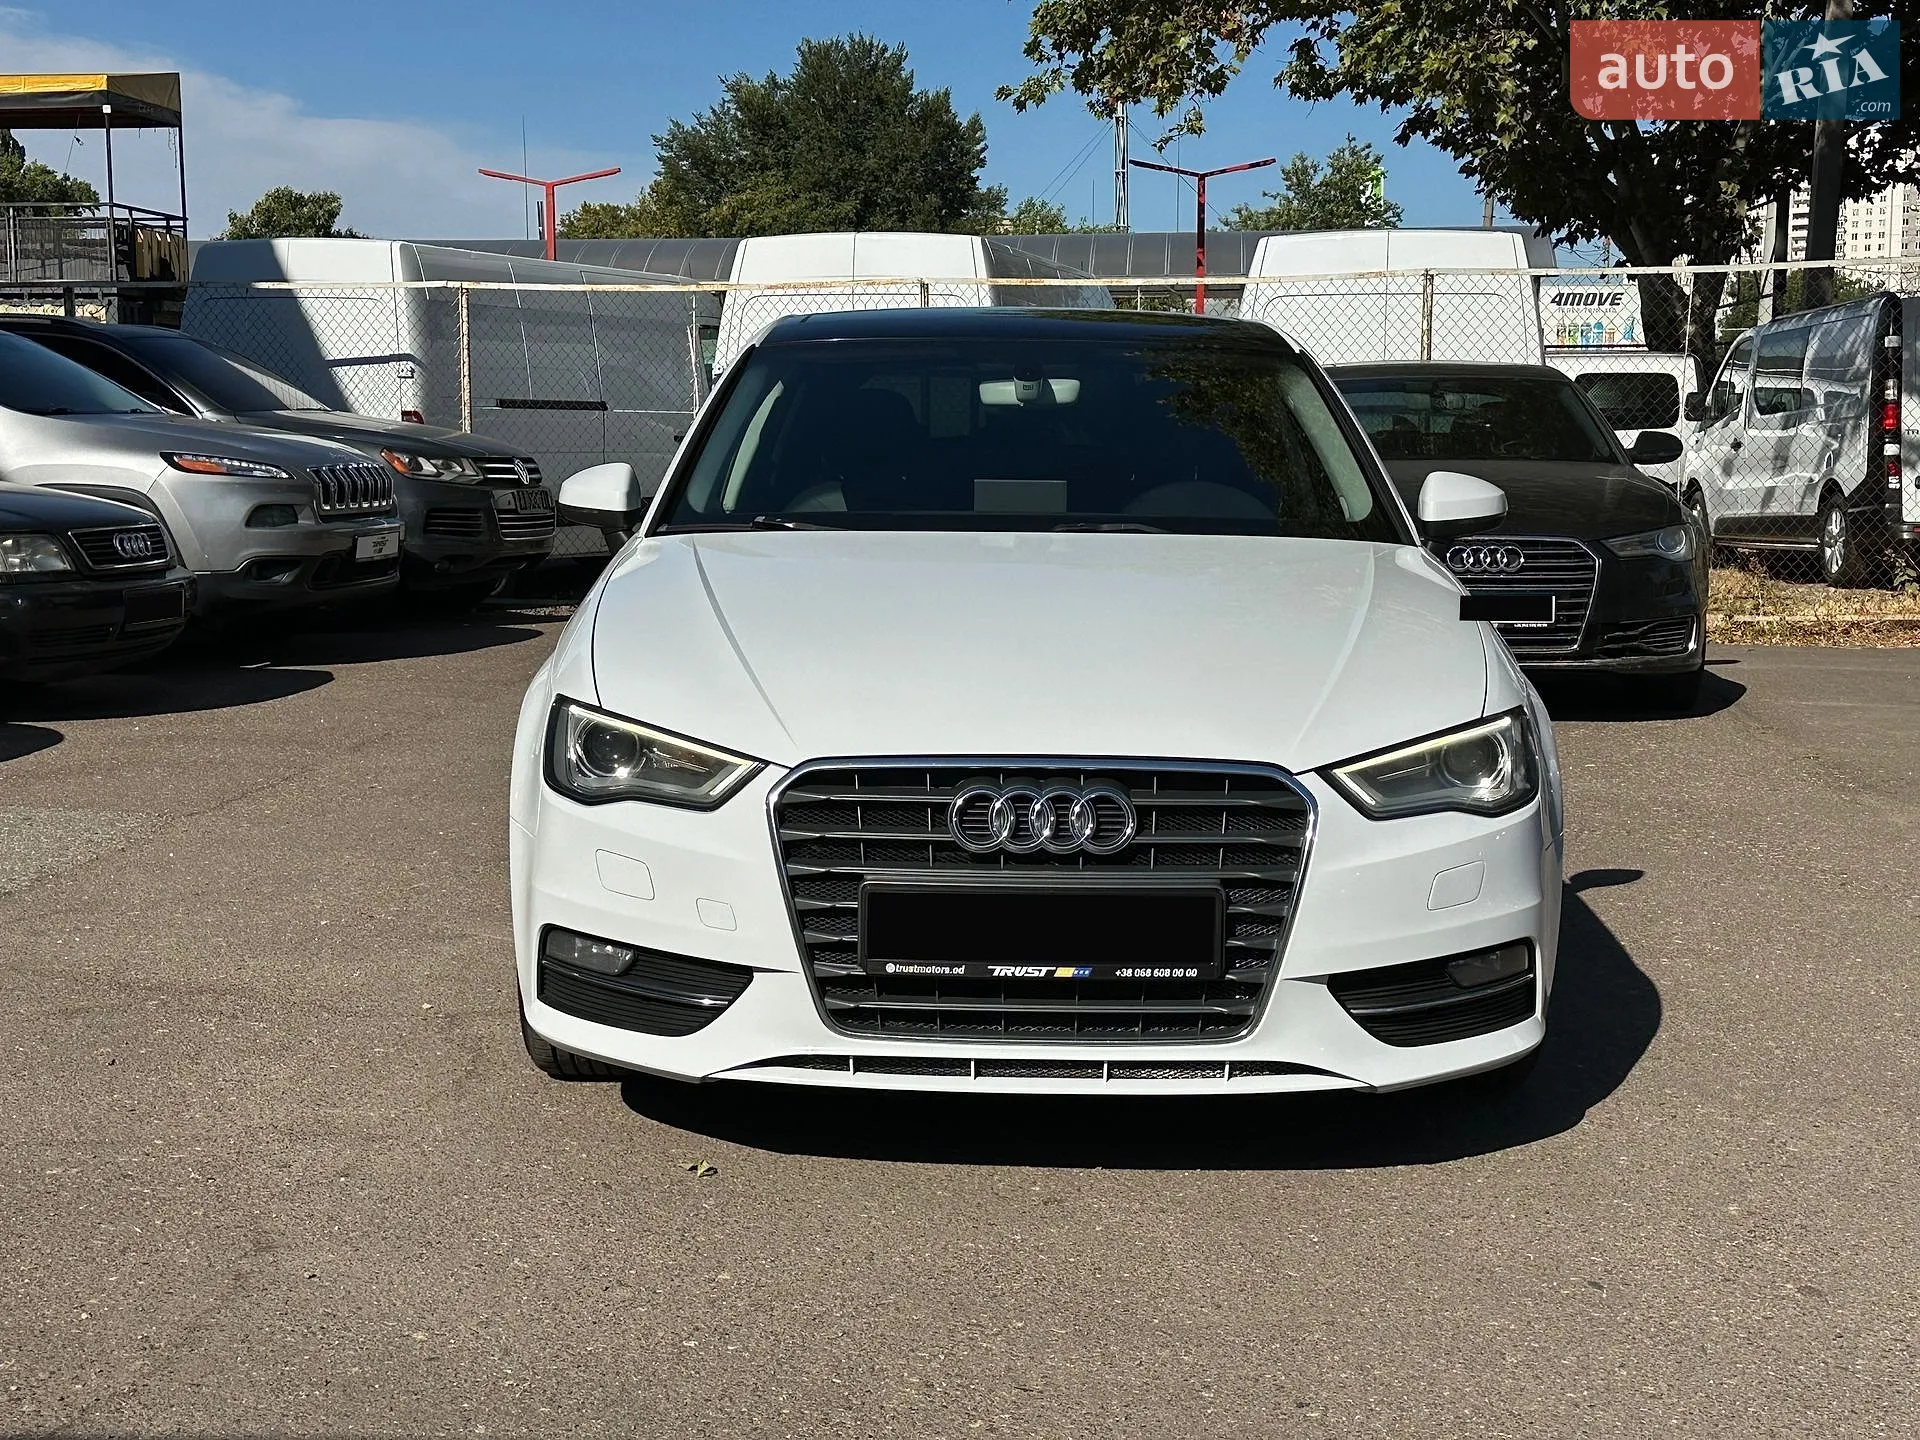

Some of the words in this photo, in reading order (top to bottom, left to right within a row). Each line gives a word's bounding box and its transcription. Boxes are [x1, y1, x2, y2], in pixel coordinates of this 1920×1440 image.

[1550, 292, 1625, 307] 4MOVE
[987, 965, 1057, 977] TRUST
[1115, 968, 1133, 977] +38
[1172, 968, 1184, 977] 00
[1185, 968, 1198, 977] 00
